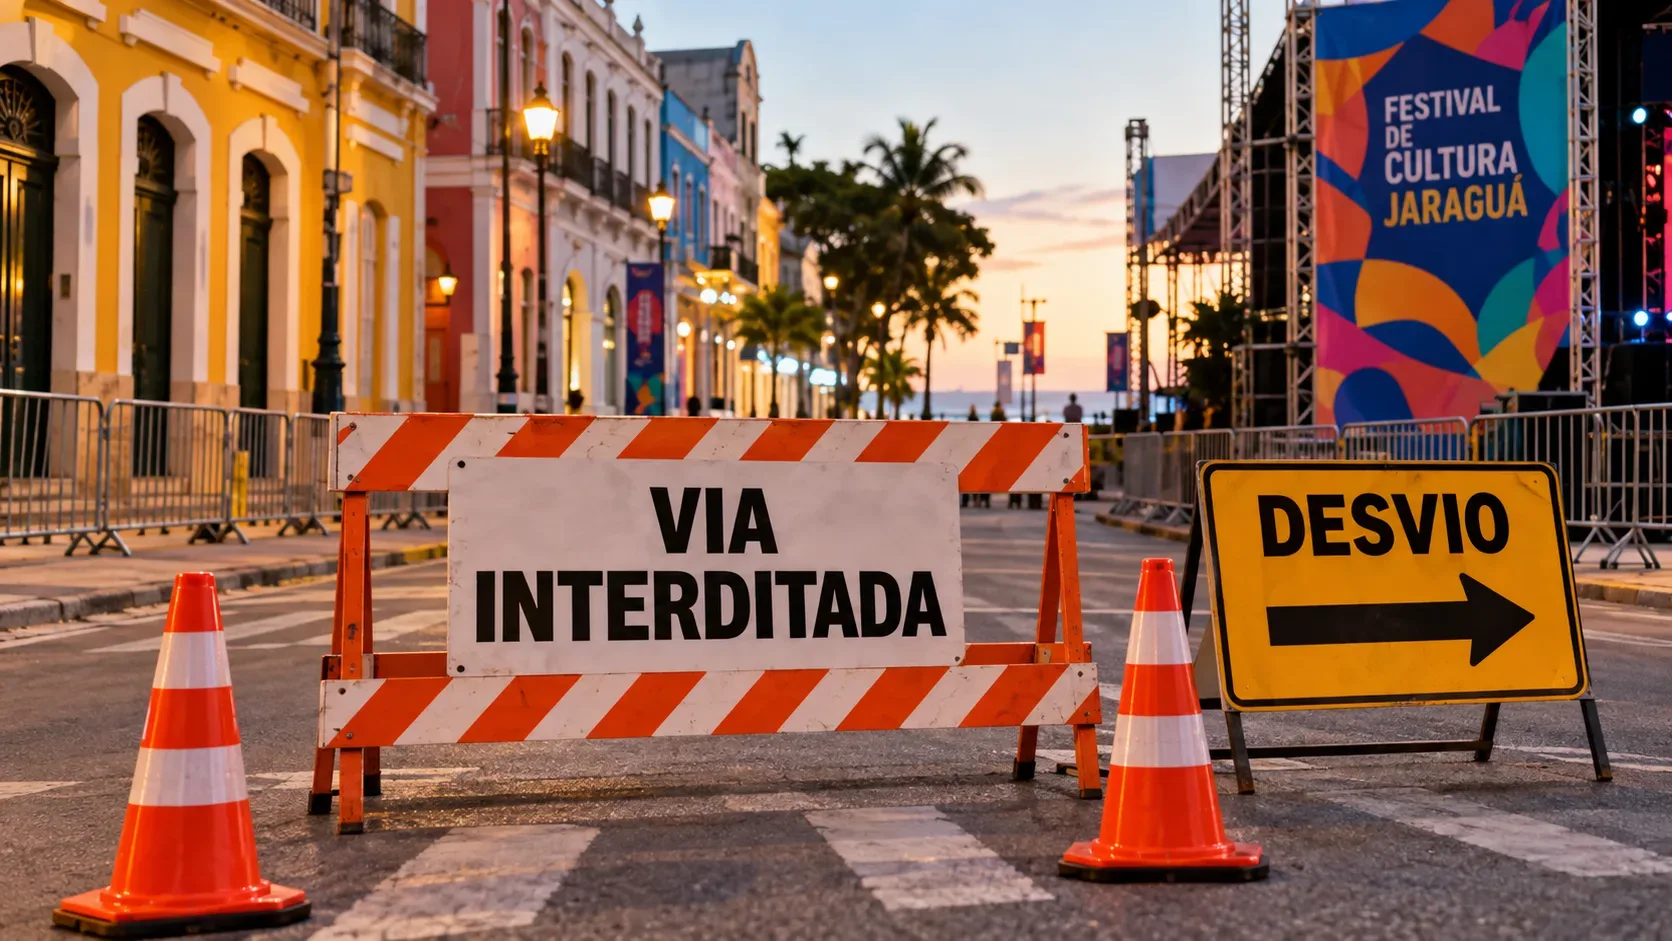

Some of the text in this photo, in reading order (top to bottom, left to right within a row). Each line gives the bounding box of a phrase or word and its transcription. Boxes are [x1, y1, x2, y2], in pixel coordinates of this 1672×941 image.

[1385, 85, 1501, 123] FESTIVAL
[1385, 124, 1414, 149] DE
[1385, 141, 1518, 185] CULTURA
[1384, 174, 1528, 228] JARAGUÁ
[650, 487, 778, 553] VIA
[1258, 492, 1509, 558] DESVIO
[476, 571, 947, 642] INTERDITADA
